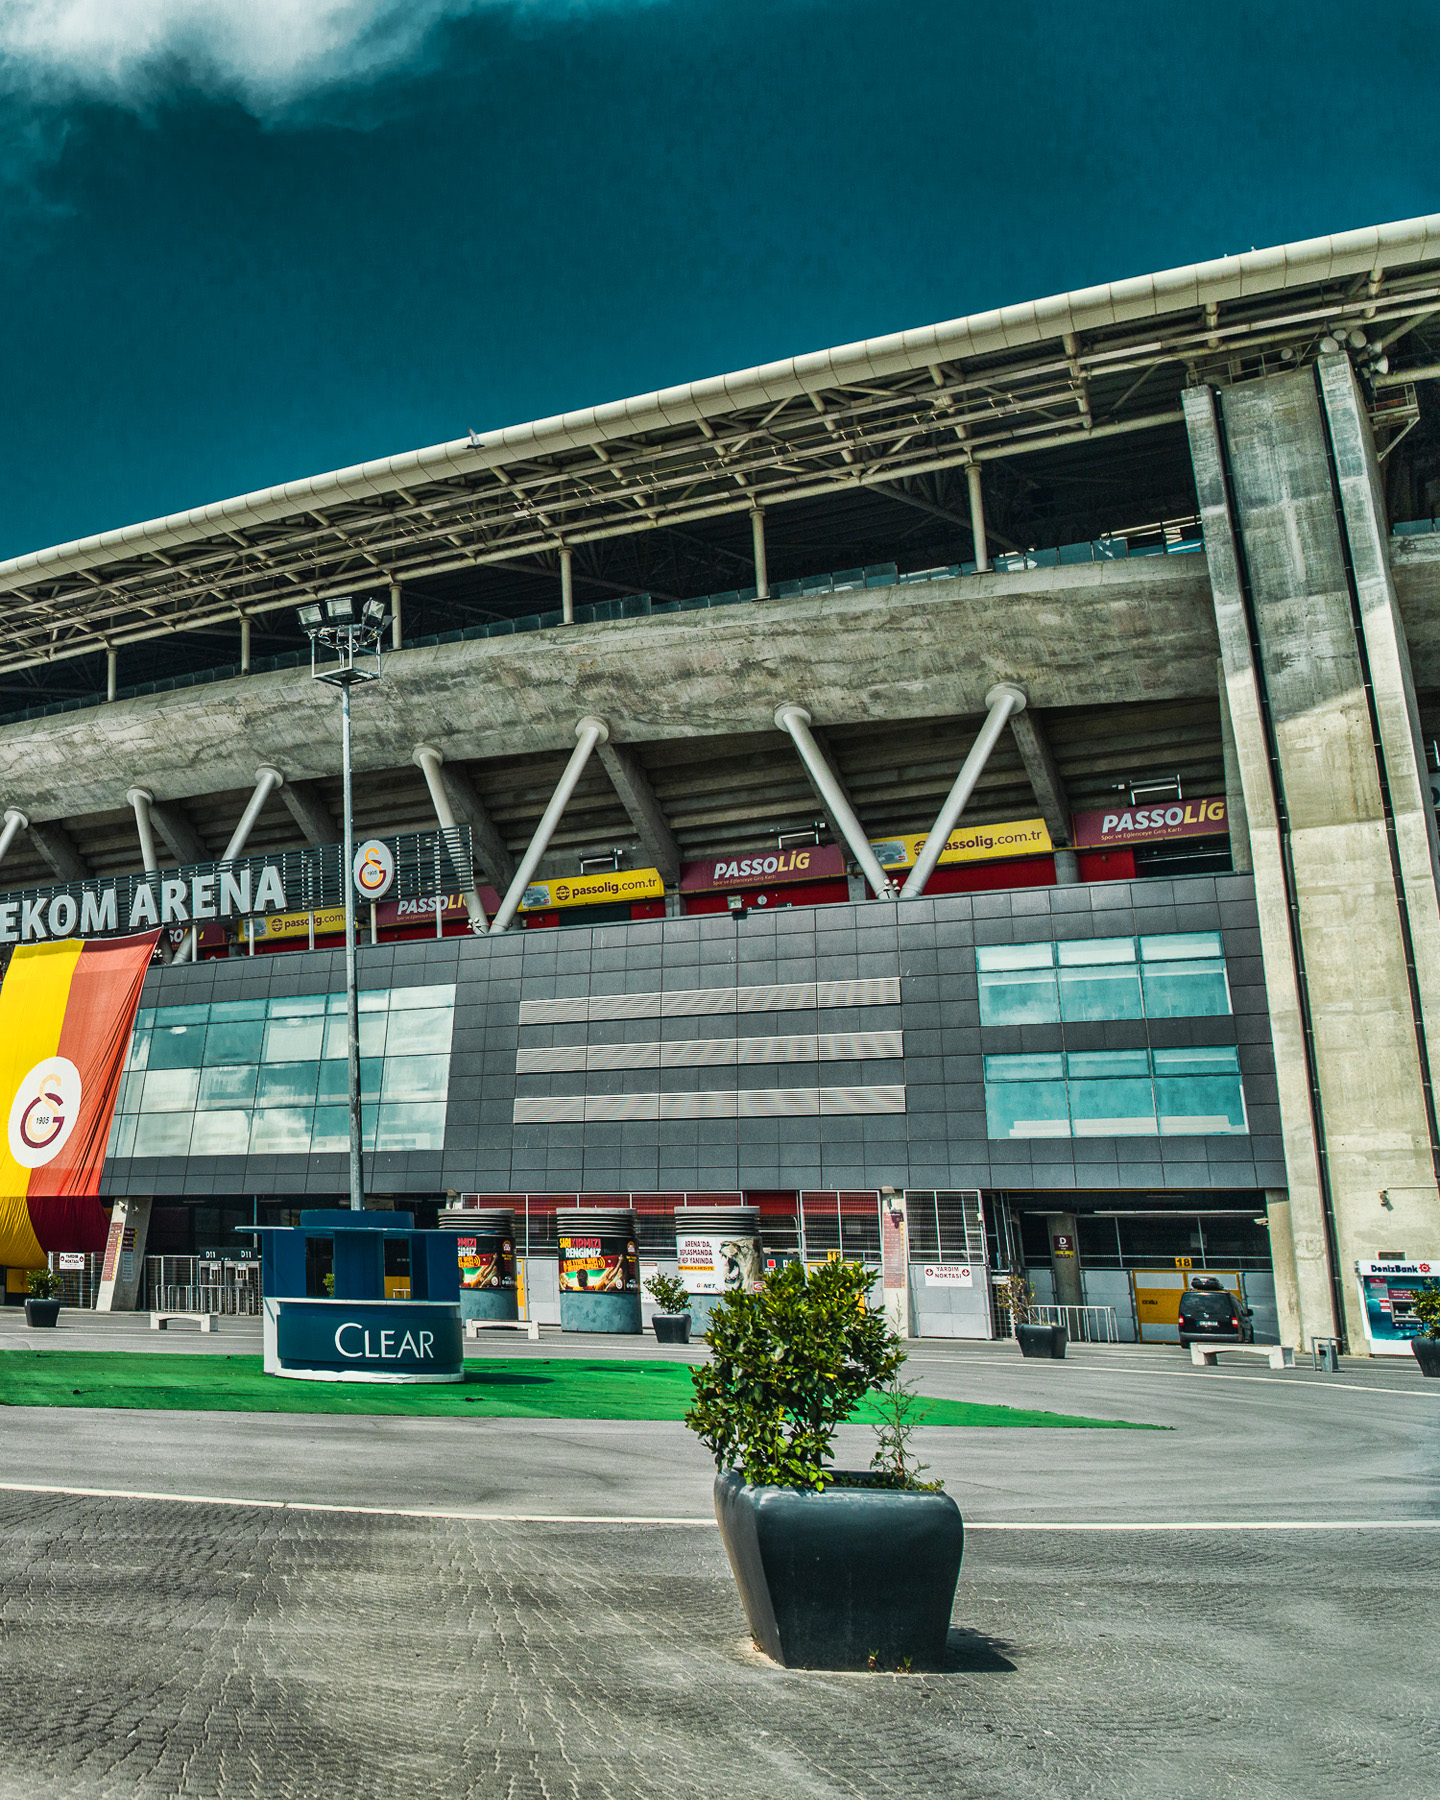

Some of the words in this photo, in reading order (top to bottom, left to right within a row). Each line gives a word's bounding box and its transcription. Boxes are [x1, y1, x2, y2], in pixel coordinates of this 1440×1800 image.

[1102, 800, 1225, 833] PASSOLİG
[944, 830, 1042, 850] assolig.com.tr
[713, 850, 811, 879] PASSOLİG
[128, 866, 289, 927] ARENA
[572, 878, 657, 898] passolig.com.tr
[1176, 1257, 1191, 1267] 18
[1370, 1264, 1419, 1273] DenizBank
